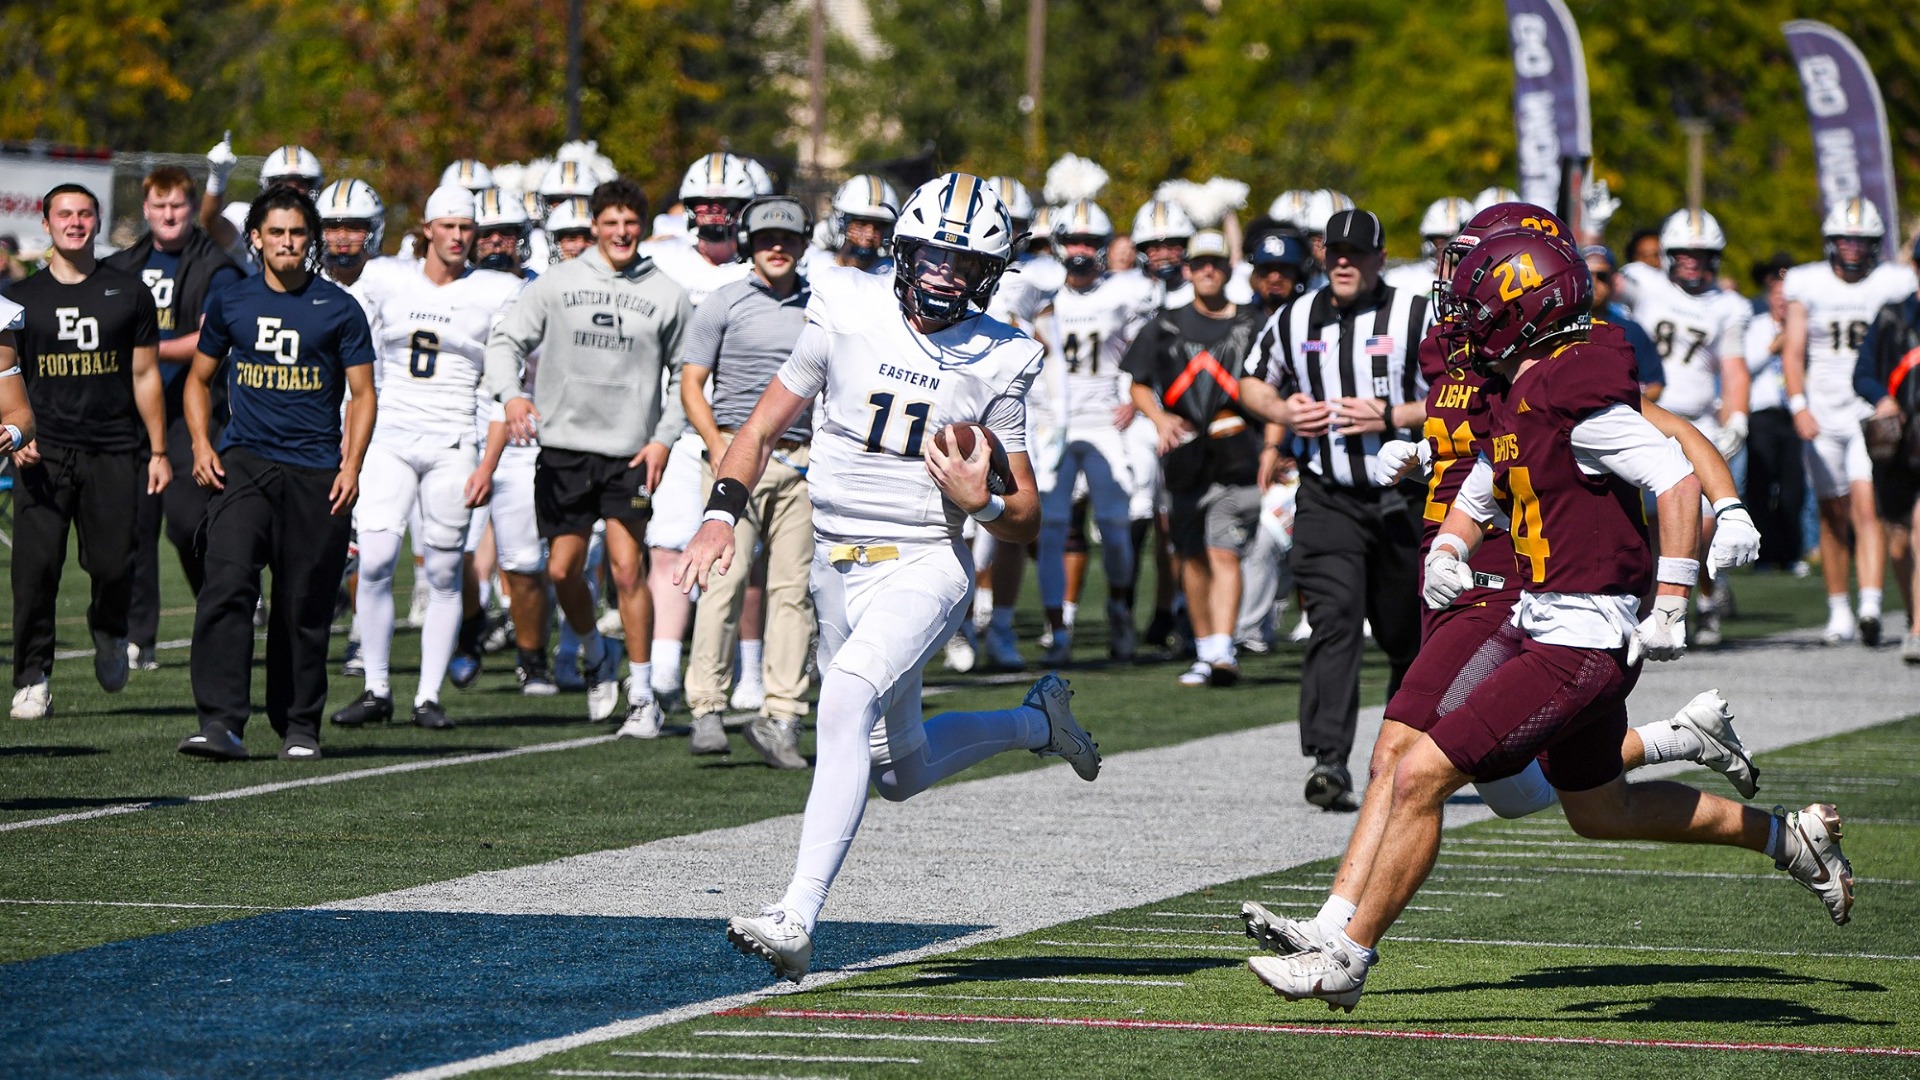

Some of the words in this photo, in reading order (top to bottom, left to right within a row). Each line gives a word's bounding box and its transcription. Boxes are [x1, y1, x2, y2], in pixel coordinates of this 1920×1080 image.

[1493, 253, 1544, 302] 24
[562, 289, 611, 309] EASTERN
[616, 291, 658, 319] OREGON
[56, 307, 99, 351] EO
[255, 316, 300, 365] EO
[574, 330, 635, 352] UNIVERSITY
[1654, 319, 1708, 364] 87
[37, 351, 119, 377] FOOTBALL
[407, 328, 440, 379] 6
[1063, 331, 1101, 375] 41
[236, 361, 323, 391] FOOTBALL
[878, 363, 940, 391] EASTERN
[1374, 376, 1389, 397] H
[1435, 384, 1480, 410] LIGH
[864, 389, 935, 457] 11
